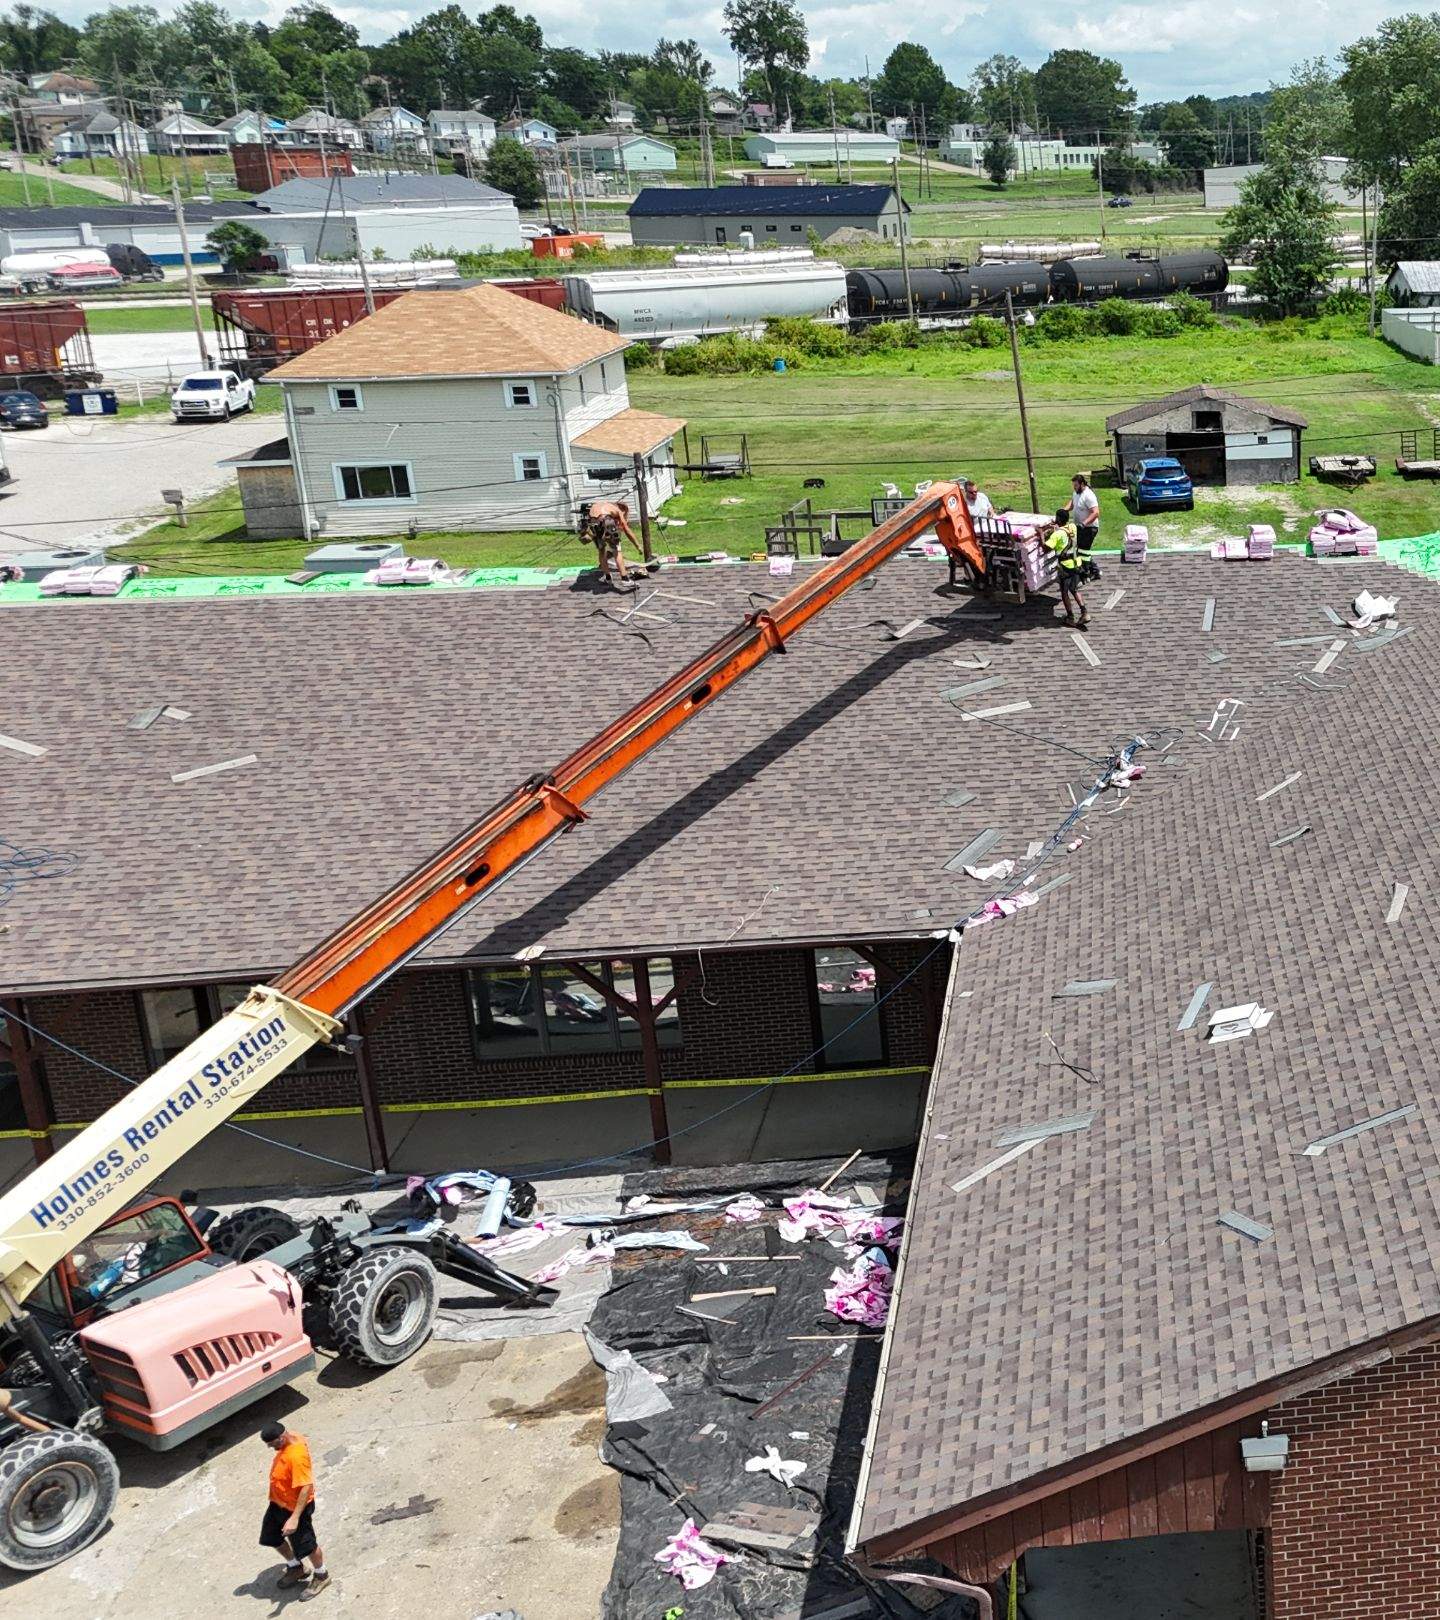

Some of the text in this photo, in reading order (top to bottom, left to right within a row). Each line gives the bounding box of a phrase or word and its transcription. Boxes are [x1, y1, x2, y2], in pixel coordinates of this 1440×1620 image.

[203, 1038, 288, 1109] 330-674-5533
[31, 1017, 286, 1228] Holmes Rental Station
[56, 1153, 150, 1231] 330-852-3600
